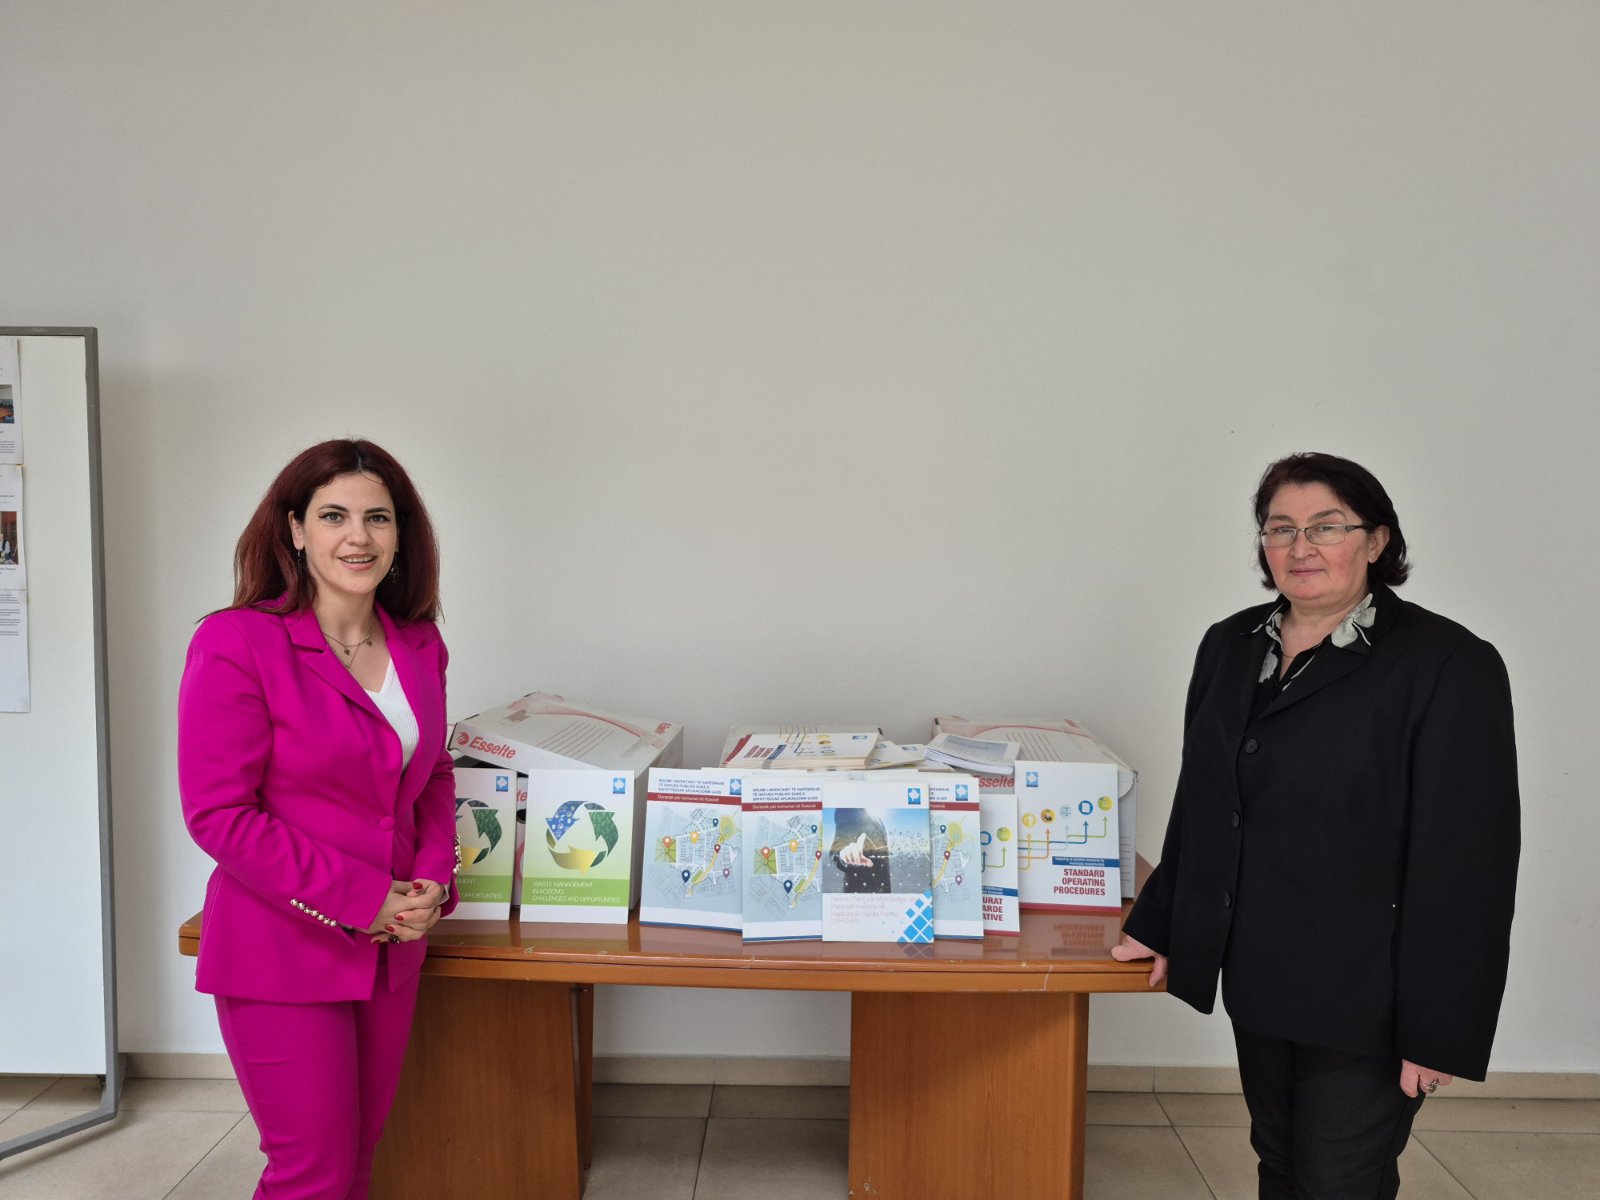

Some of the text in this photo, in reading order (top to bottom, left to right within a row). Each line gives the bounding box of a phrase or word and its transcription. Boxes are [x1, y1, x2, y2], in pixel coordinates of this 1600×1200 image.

[470, 736, 516, 759] Esselte
[973, 774, 1016, 788] sselte
[1064, 868, 1105, 877] STANDARD
[1062, 877, 1105, 886] OPERATING
[1053, 886, 1106, 896] PROCEDURES
